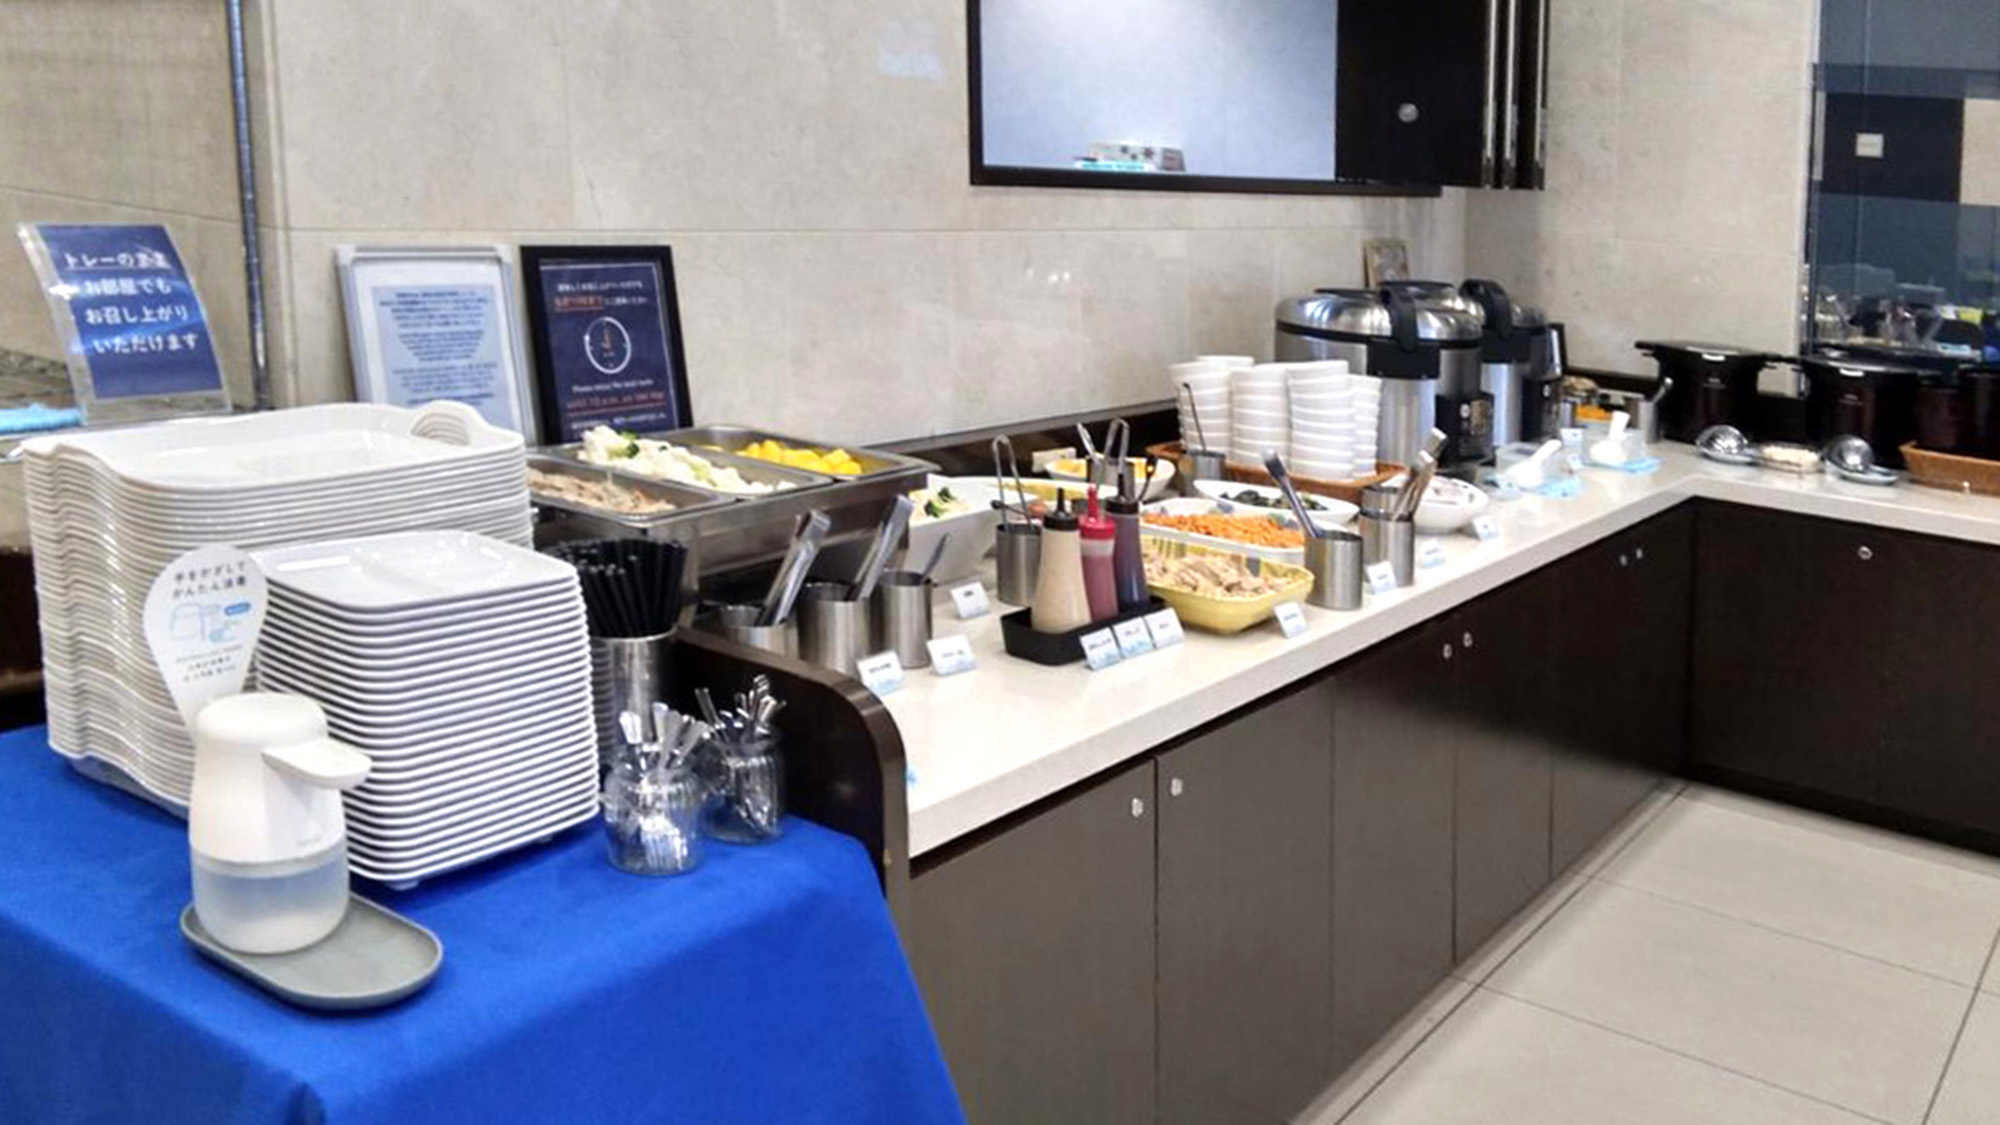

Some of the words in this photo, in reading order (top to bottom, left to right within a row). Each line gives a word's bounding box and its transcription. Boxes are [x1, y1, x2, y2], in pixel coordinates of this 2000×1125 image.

[65, 252, 171, 269] トレーのまま
[84, 278, 171, 295] お部屋でも
[86, 304, 189, 325] お召し上がり
[92, 333, 199, 354] いただけます
[174, 561, 246, 582] 手をかざして
[173, 575, 246, 599] かんたん消毒
